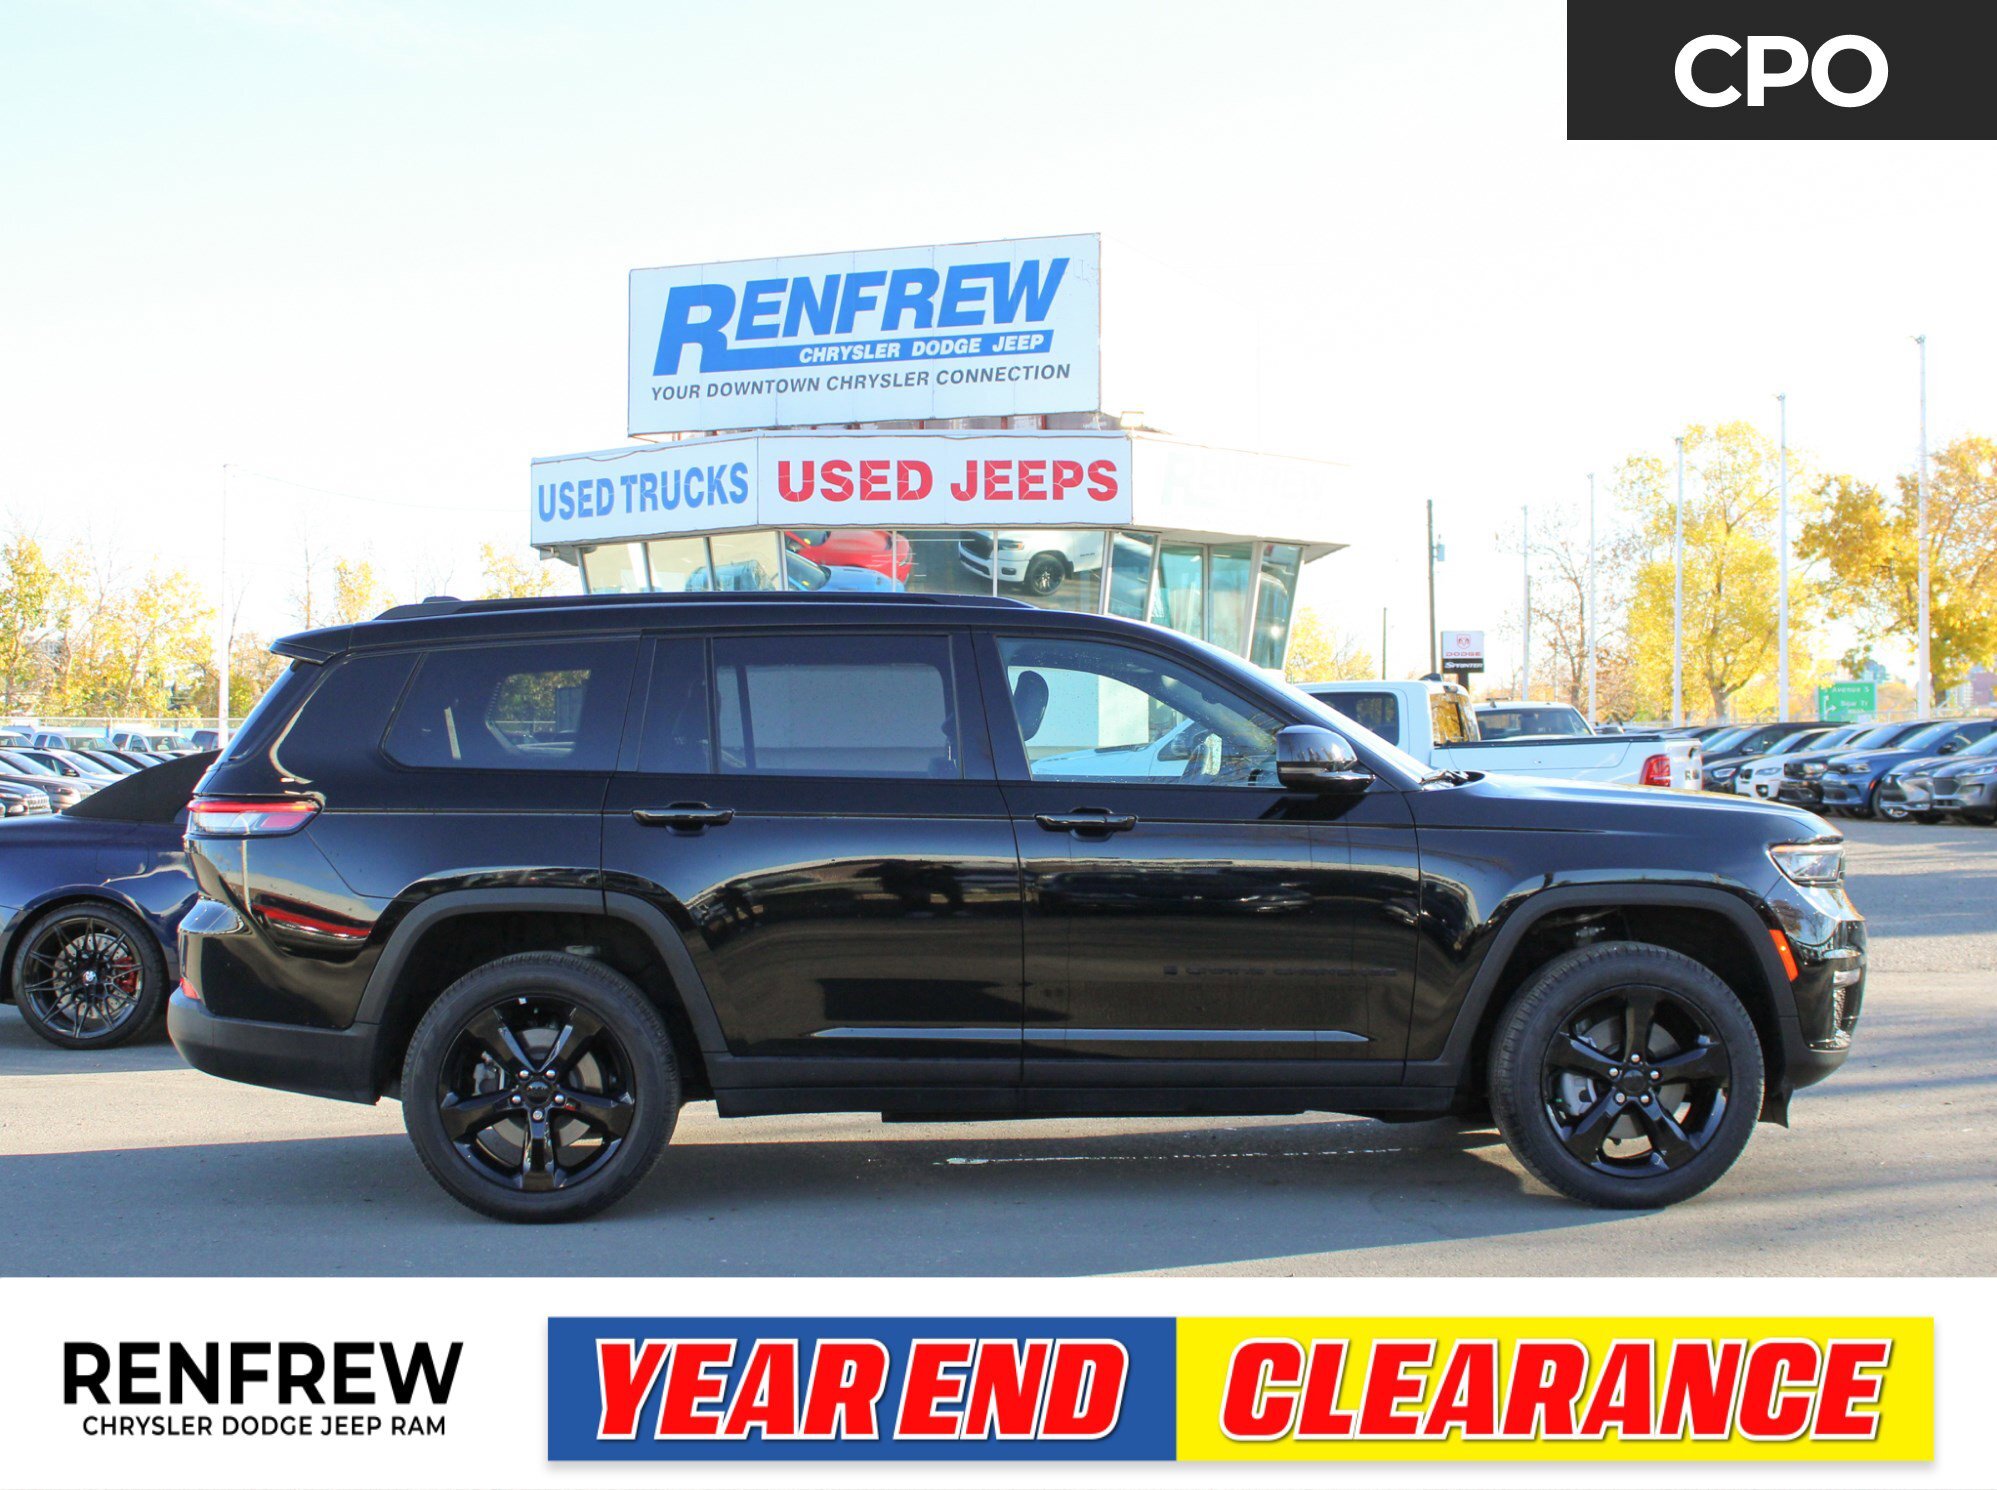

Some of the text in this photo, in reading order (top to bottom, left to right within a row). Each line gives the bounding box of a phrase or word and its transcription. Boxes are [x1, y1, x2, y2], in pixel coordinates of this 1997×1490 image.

[653, 257, 1071, 377] RENFREW
[799, 333, 1044, 364] CHRYSLER DODGE JEEP
[651, 363, 1071, 401] YOUR DOWNTOWN CHRYSLER CONNECTION
[537, 461, 749, 524] USED TRUCKS
[778, 459, 1118, 502] USED JEEPS
